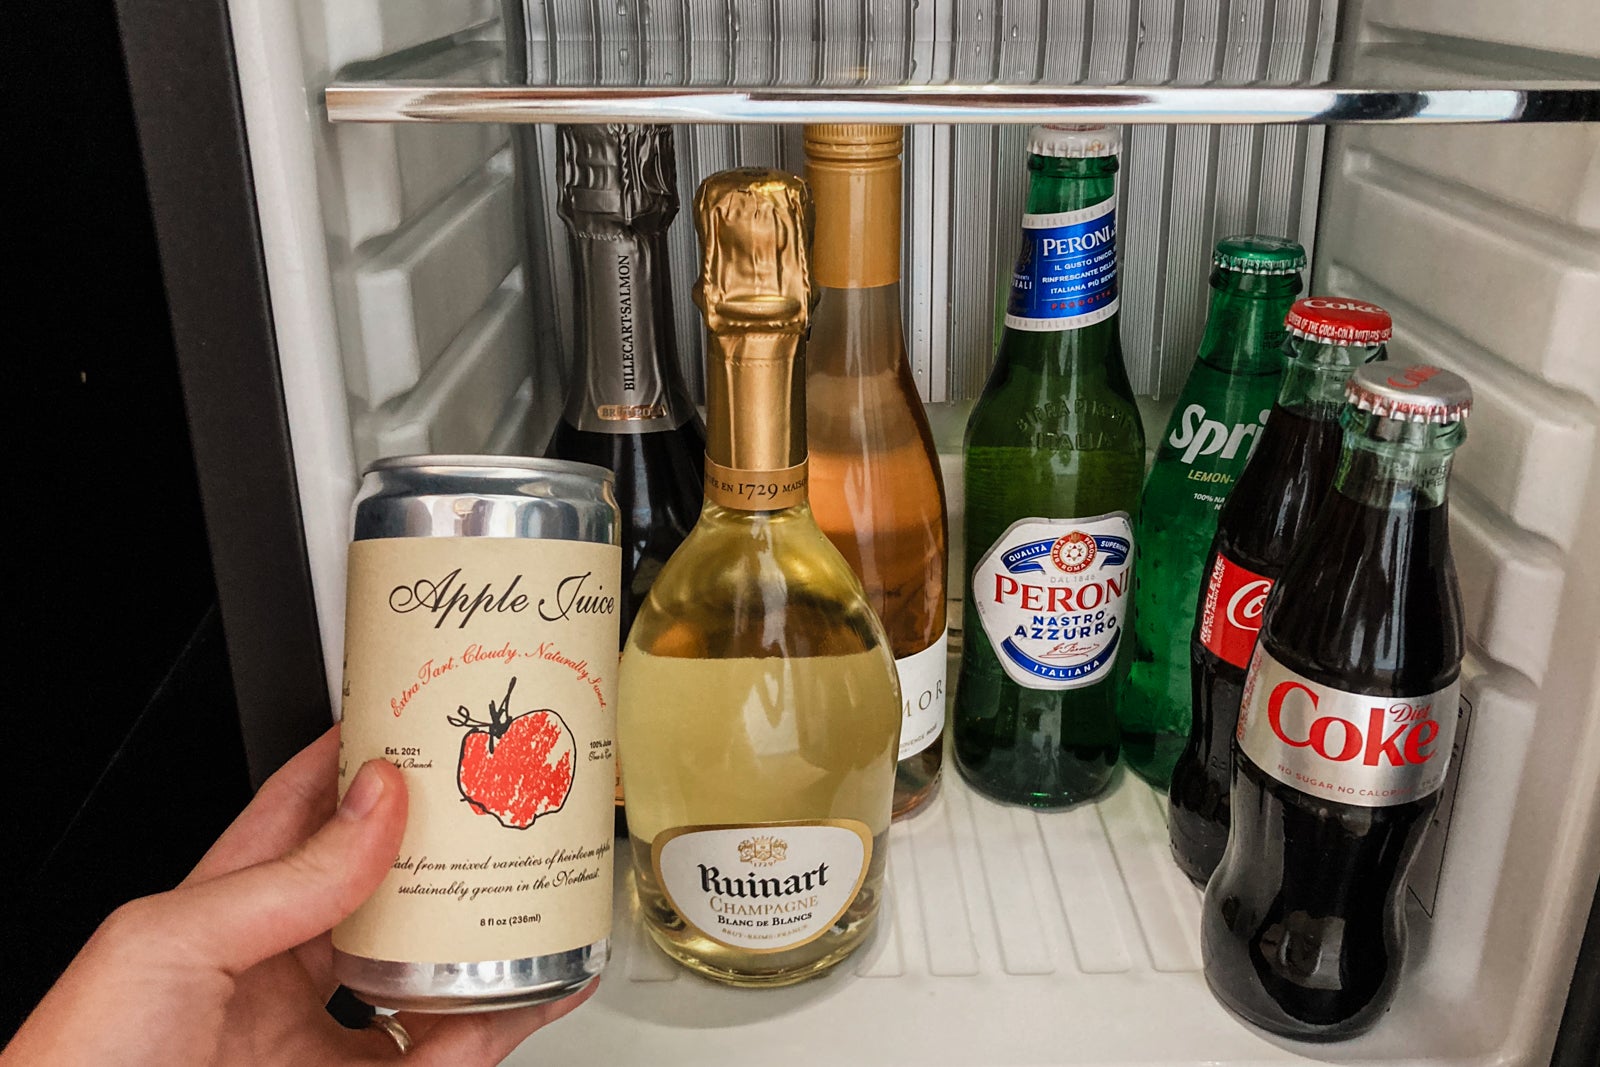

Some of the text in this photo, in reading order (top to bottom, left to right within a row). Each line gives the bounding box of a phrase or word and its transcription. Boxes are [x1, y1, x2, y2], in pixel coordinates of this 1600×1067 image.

[1043, 225, 1110, 257] PERONI
[1064, 259, 1092, 270] GUSTO
[1042, 270, 1098, 283] RINFRESCANTE
[1051, 284, 1086, 295] ITALIANA
[1303, 300, 1384, 314] Coke
[721, 483, 734, 493] EN
[738, 483, 778, 500] 1729
[1009, 543, 1047, 562] QUALITÀ
[1052, 537, 1096, 572] BIRRA PERONI ROMA
[388, 568, 615, 629] Apple Juice
[994, 566, 1129, 612] PERONI
[1200, 556, 1224, 643] RECYCLE ME
[1014, 616, 1117, 640] AZZURRO
[1033, 610, 1105, 626] NASTRO
[1034, 660, 1100, 677] ITALIANA
[390, 683, 420, 718] Extra
[525, 642, 589, 680] Naturally
[1389, 702, 1432, 723] Diet
[1268, 681, 1440, 767] Coke
[401, 747, 420, 756] 2021
[1278, 764, 1292, 776] NO
[1295, 772, 1333, 790] SUGAR
[1338, 786, 1355, 795] NO
[393, 857, 414, 870] ade
[413, 856, 446, 875] from
[450, 856, 489, 870] mixed
[492, 856, 542, 869] varieties
[545, 849, 560, 870] of
[557, 846, 594, 862] heirloom
[398, 881, 469, 901] sustainably
[471, 886, 513, 901] grown
[516, 880, 529, 892] in
[533, 876, 550, 889] the
[697, 862, 829, 899] Ruinart
[709, 895, 818, 915] CHAMPAGNE
[480, 914, 542, 927] 8 fl oz (236ml)
